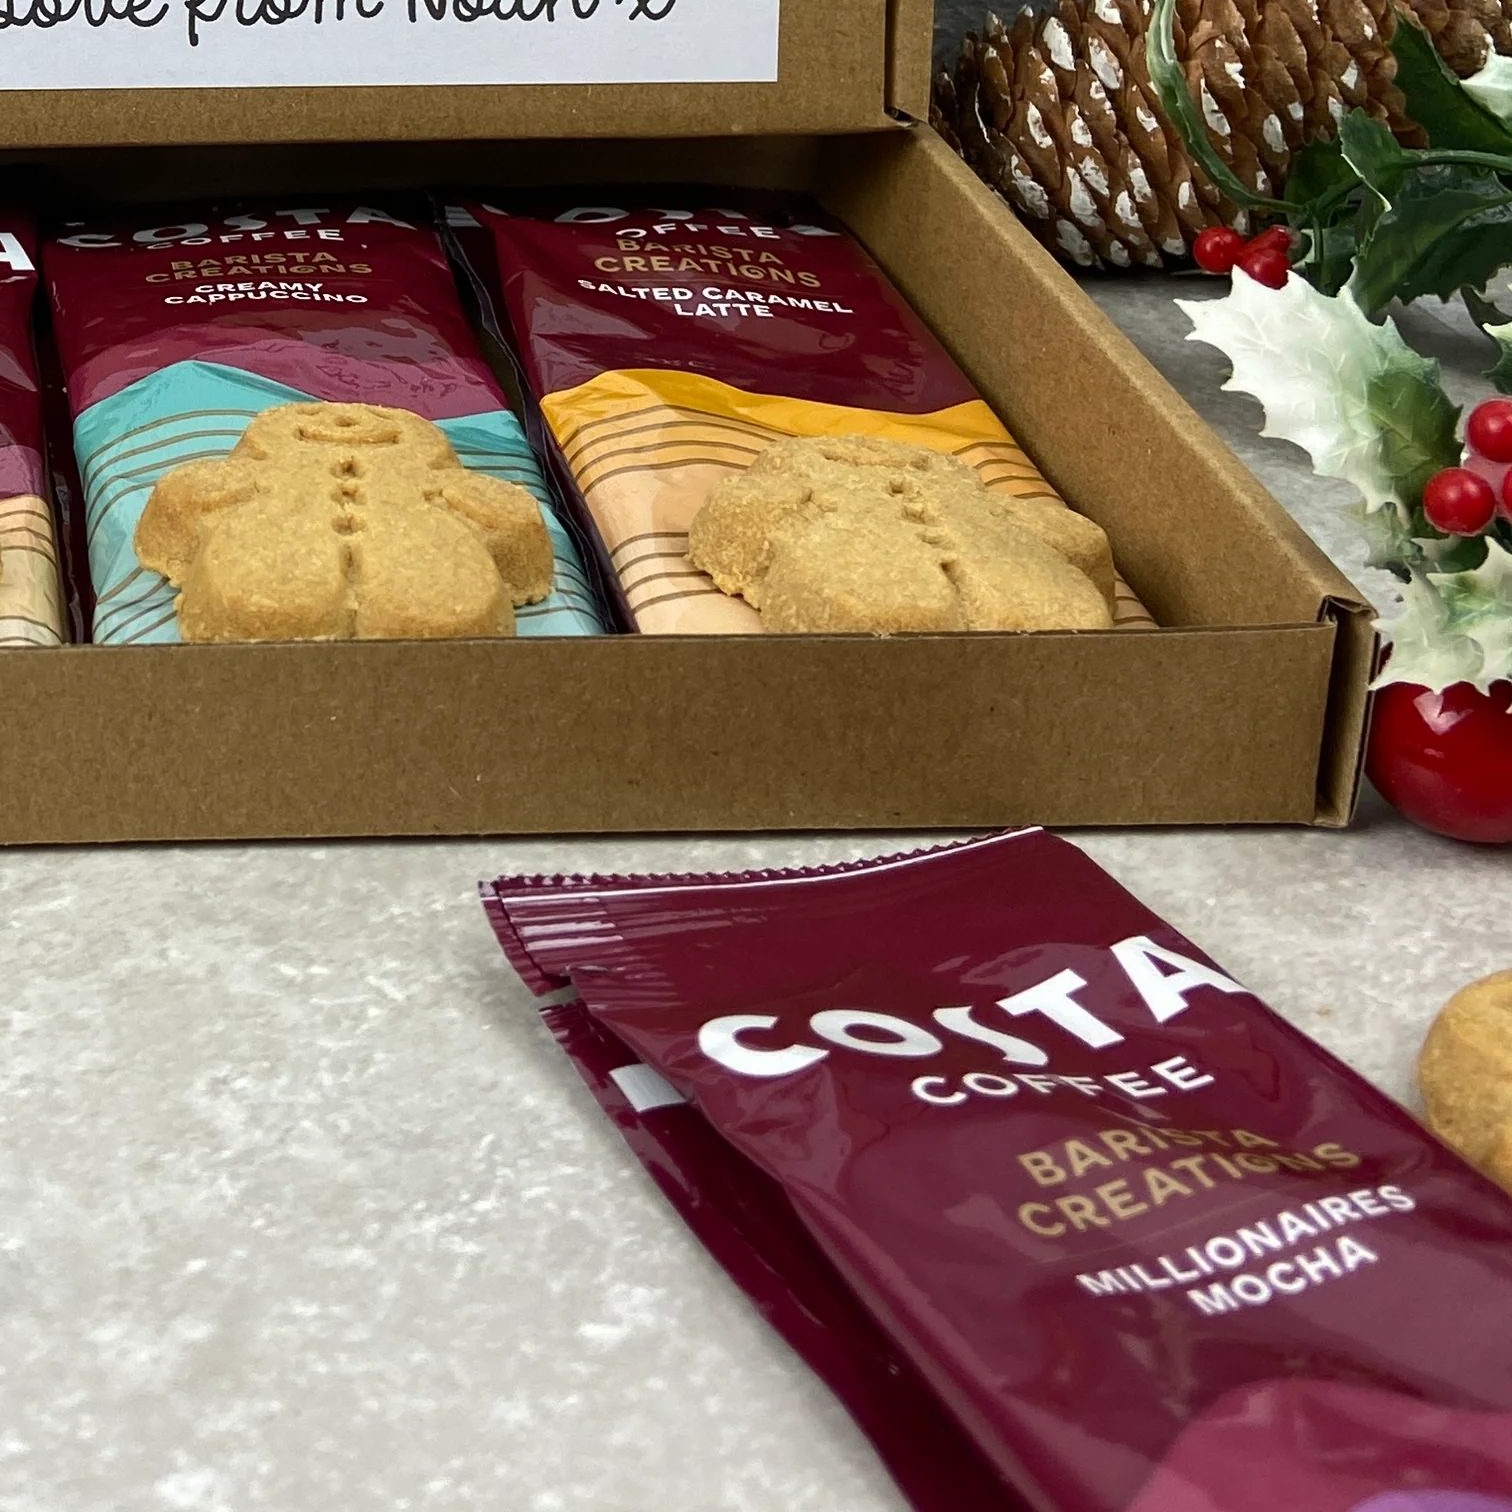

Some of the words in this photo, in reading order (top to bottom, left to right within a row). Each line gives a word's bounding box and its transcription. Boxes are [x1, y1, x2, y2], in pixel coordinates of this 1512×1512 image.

[146, 228, 345, 251] COFFEE
[615, 238, 785, 266] BARISTA
[144, 263, 374, 285] CREATIONS
[170, 251, 339, 272] BARISTA
[593, 255, 822, 289] CREATIONS
[163, 291, 369, 306] CAPPUCCINO
[194, 281, 325, 294] CREAMY
[577, 279, 694, 301] SALTED
[701, 286, 854, 315] CARAMEL
[674, 302, 776, 319] LATTE
[697, 934, 1250, 1079] COSTA
[911, 1055, 1216, 1108] COFFEE
[1017, 1126, 1280, 1188] BARISTA
[1017, 1141, 1362, 1239] CREATIONS
[1076, 1184, 1418, 1299] MILLIONAIRES
[1187, 1234, 1379, 1317] MOCHA
